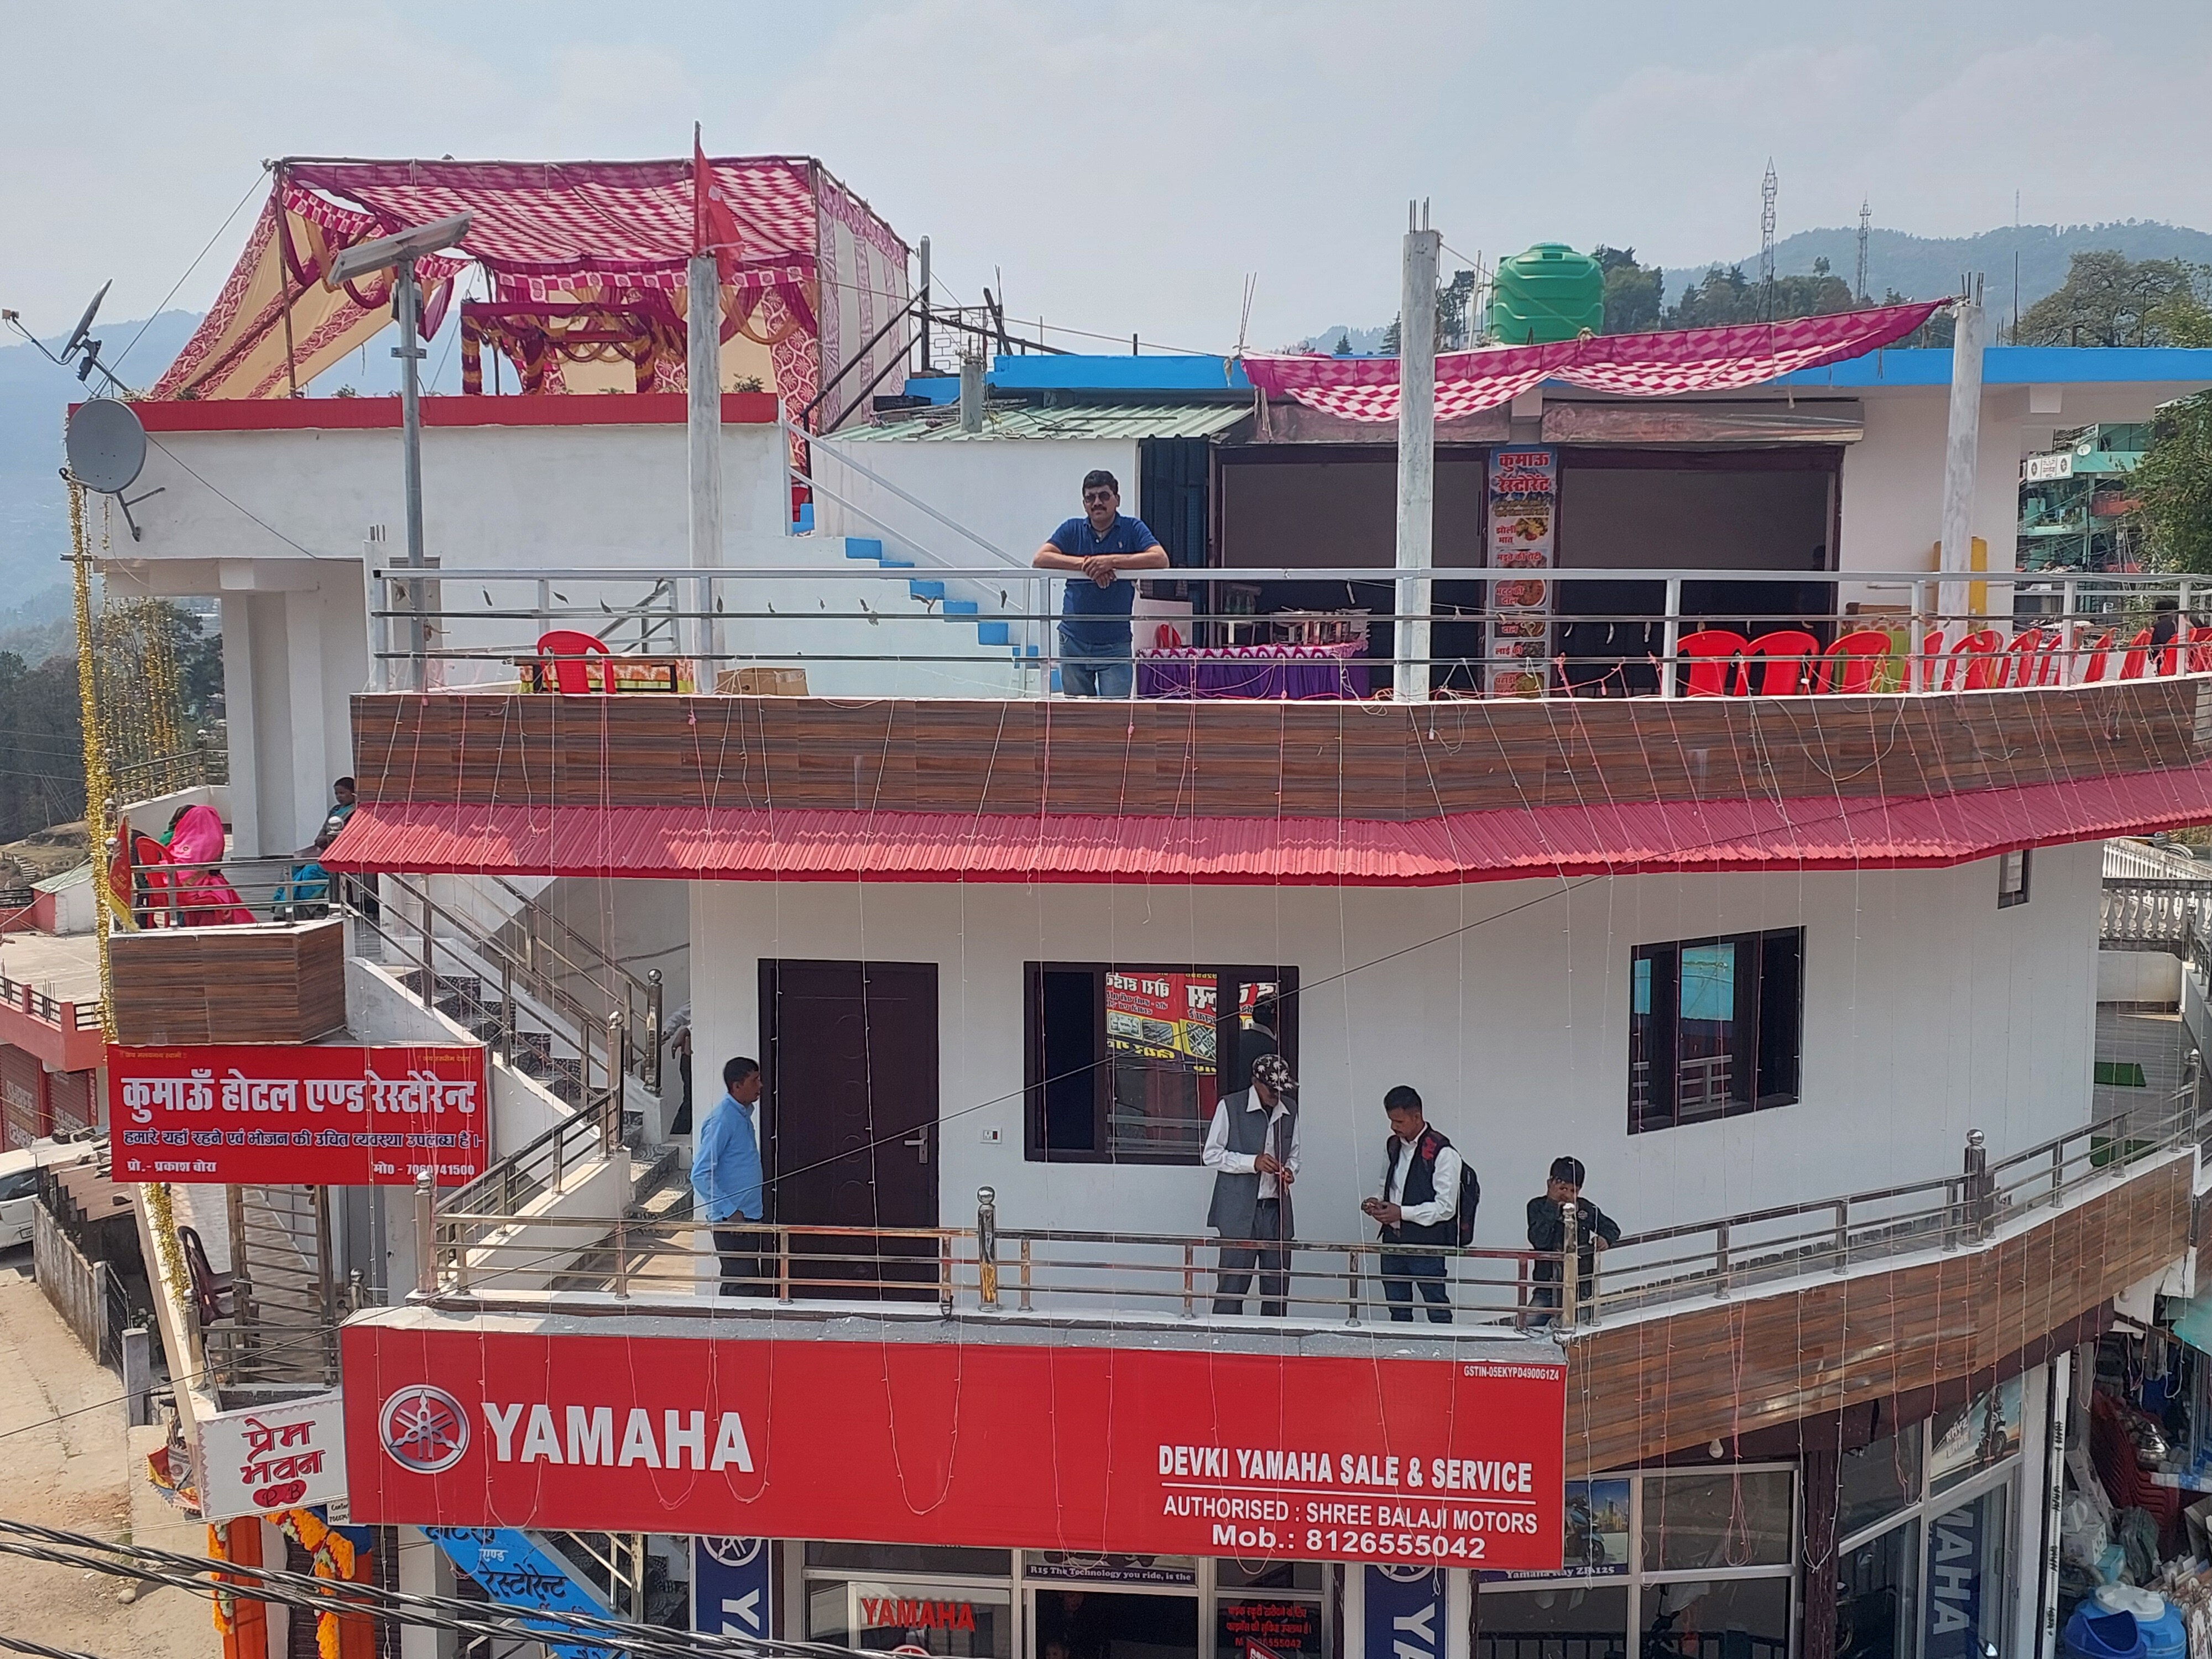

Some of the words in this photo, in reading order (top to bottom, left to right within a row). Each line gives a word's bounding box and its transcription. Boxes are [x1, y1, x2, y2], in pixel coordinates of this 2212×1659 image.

[1501, 625, 1519, 634] दाल
[121, 1068, 215, 1123] कुमाऊँ
[219, 1068, 299, 1112] होटल
[304, 1079, 365, 1113] एण्ड
[364, 1070, 477, 1113] रेस्टोरेन्ट
[123, 1127, 159, 1146] हमारे
[192, 1128, 223, 1146] रहने
[226, 1128, 246, 1146] एवं
[247, 1129, 290, 1146] भोजन
[292, 1129, 311, 1146] की
[315, 1128, 350, 1147] उचित
[353, 1133, 404, 1147] व्यवस्था
[406, 1133, 456, 1147] उपलब्ध
[154, 1161, 191, 1172] प्रकाश
[192, 1159, 217, 1172] बोरा
[406, 1164, 475, 1176] 7060741500
[241, 1418, 316, 1463] प्रेम
[481, 1402, 754, 1473] YAMAHA
[239, 1449, 326, 1485] भवन
[1159, 1444, 1228, 1478] DEVKI
[1236, 1448, 1333, 1483] YAMAHA
[1340, 1454, 1399, 1486] SALE
[1407, 1457, 1423, 1488] &
[1431, 1458, 1532, 1493] SERVICE
[1164, 1495, 1289, 1521] AUTHORISED
[1306, 1502, 1372, 1525] SHREE
[1378, 1505, 1447, 1530] BALAJI
[1453, 1509, 1538, 1535] MOTORS
[478, 1548, 509, 1563] एण्ड
[1306, 1529, 1486, 1559] 8126555042
[475, 1561, 570, 1601] रेस्टोरेन्ट
[1030, 1566, 1048, 1575] R15
[1050, 1567, 1068, 1575] The
[1069, 1568, 1121, 1579] Technology
[1123, 1572, 1140, 1580] you
[1142, 1571, 1164, 1580] ride,
[1166, 1572, 1173, 1580] is
[1933, 1500, 1974, 1635] MAHA
[861, 1598, 975, 1631] YAMAHA
